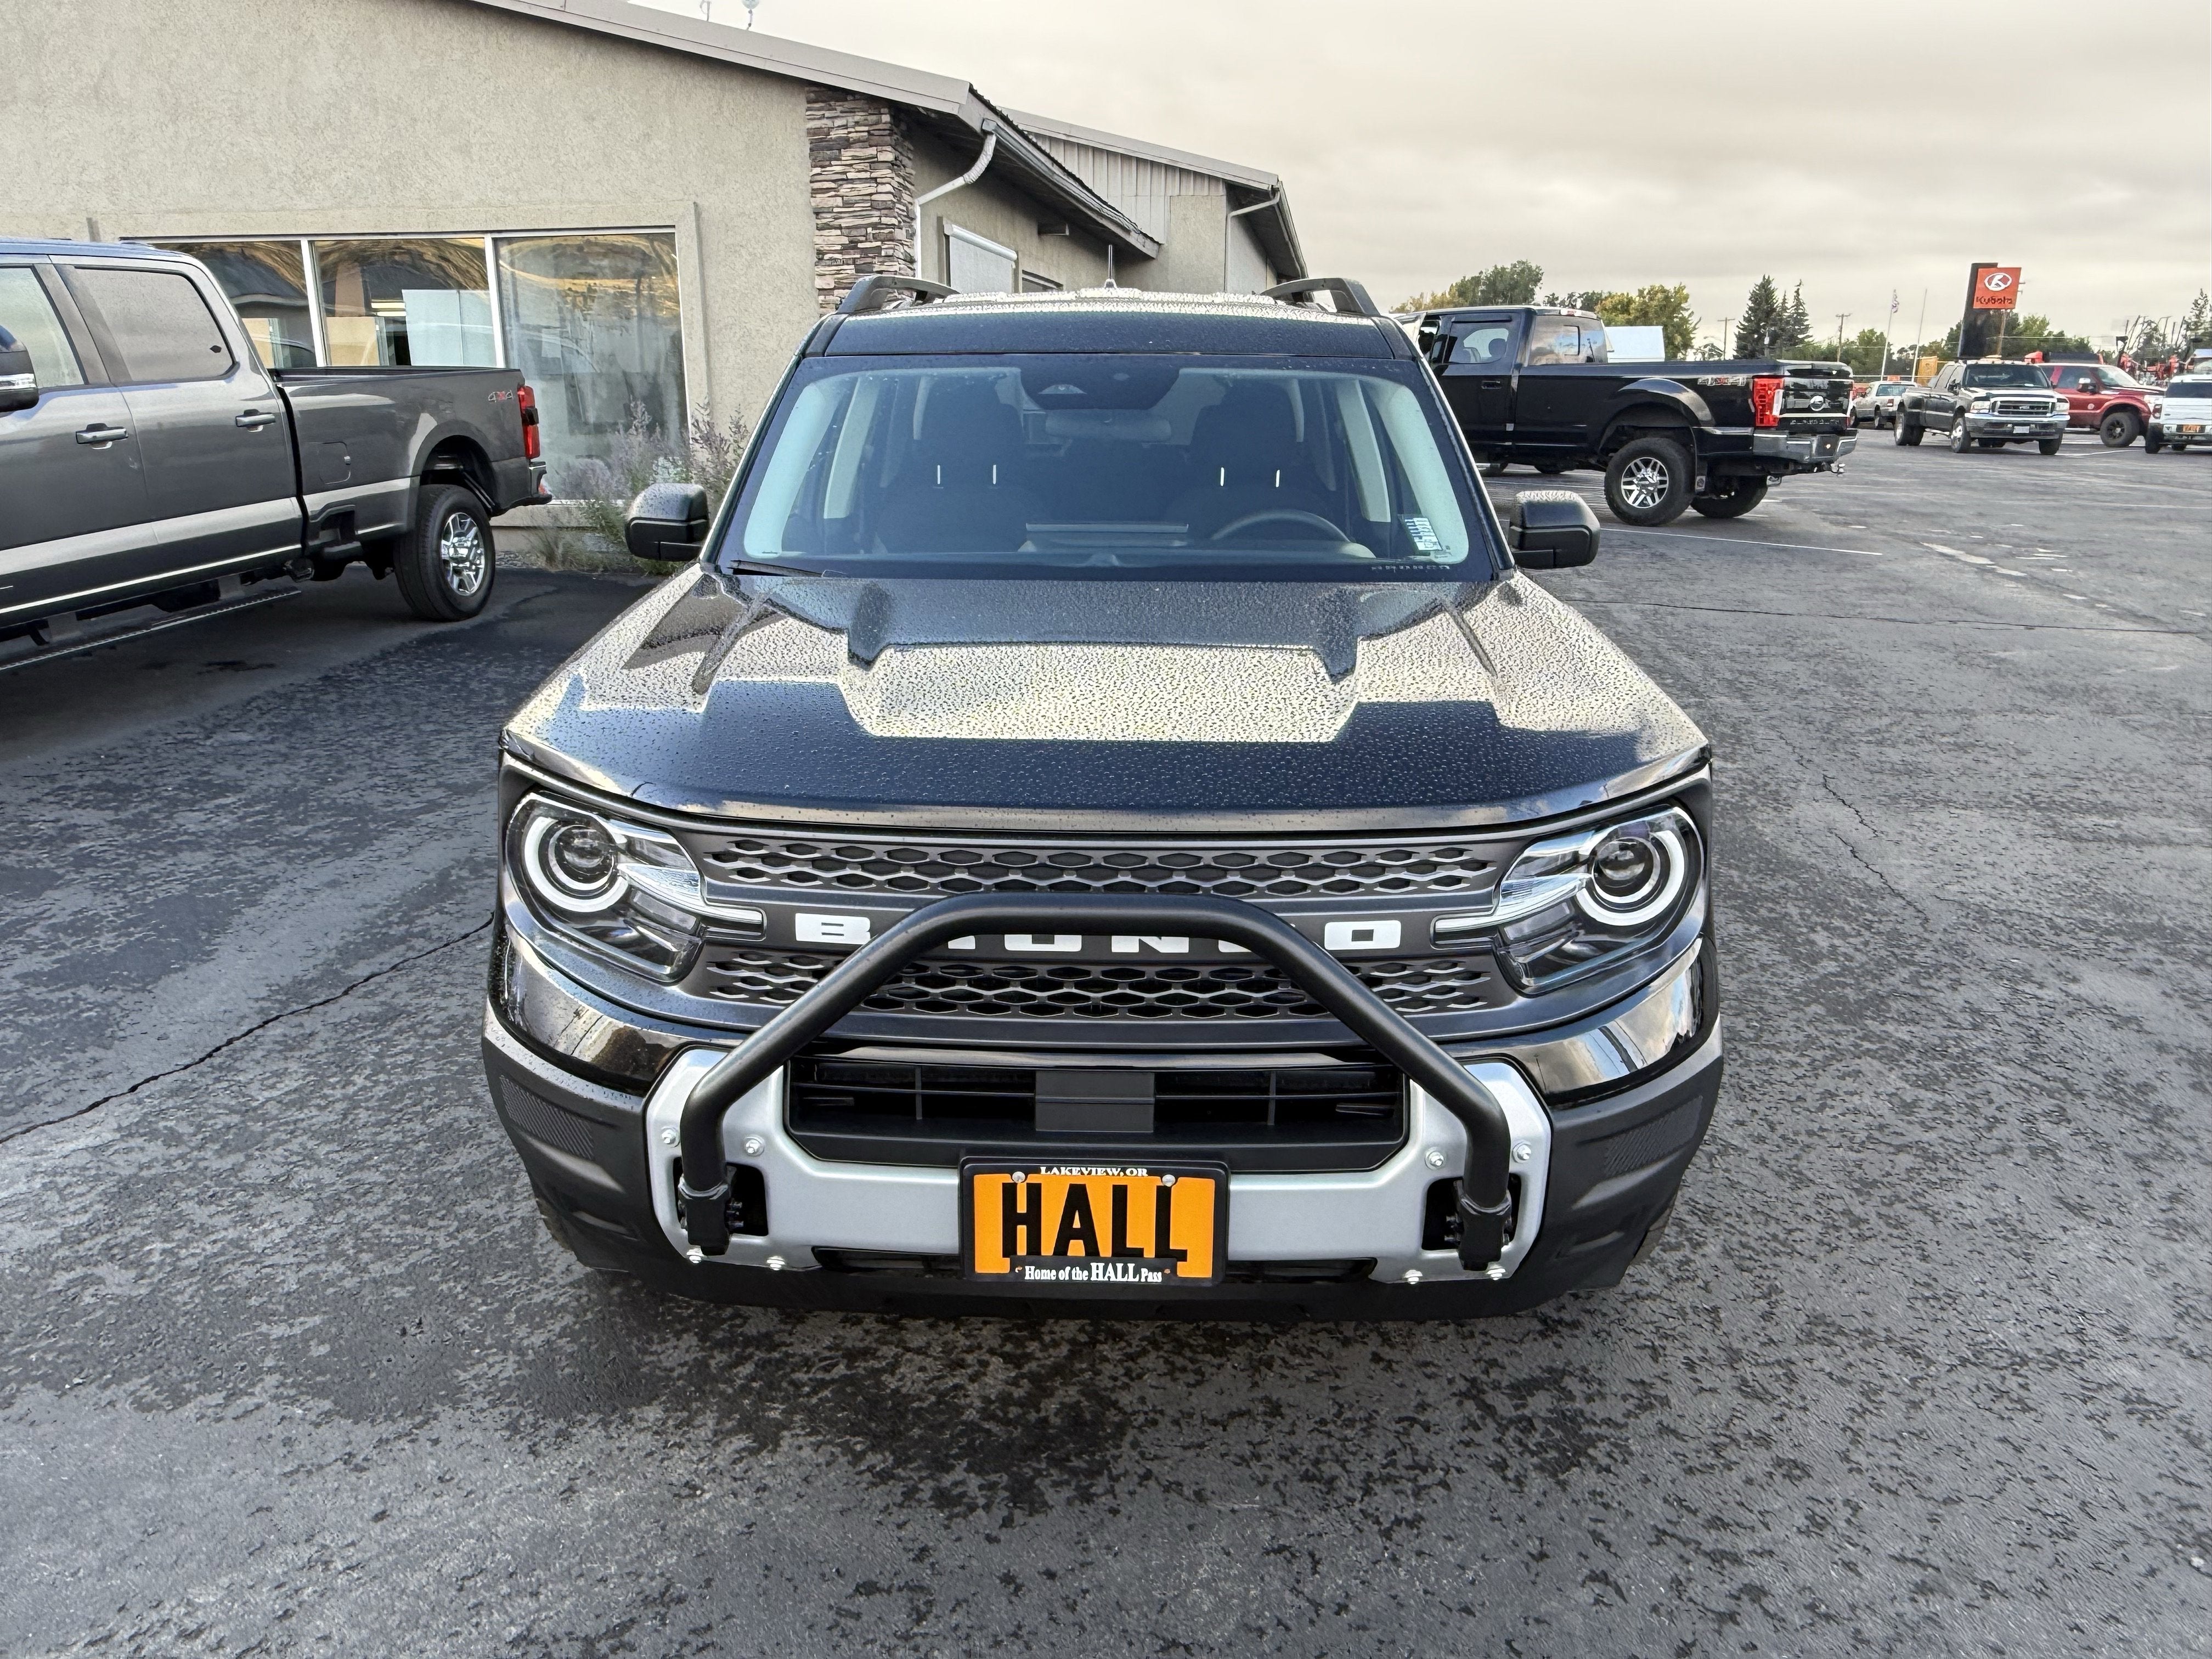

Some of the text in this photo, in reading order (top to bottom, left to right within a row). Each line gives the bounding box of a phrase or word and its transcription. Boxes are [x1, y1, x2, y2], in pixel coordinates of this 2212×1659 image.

[1126, 1167, 1148, 1177] OR
[1002, 1182, 1188, 1262] HALL
[1024, 1262, 1163, 1283] Home of the HALL Pass
